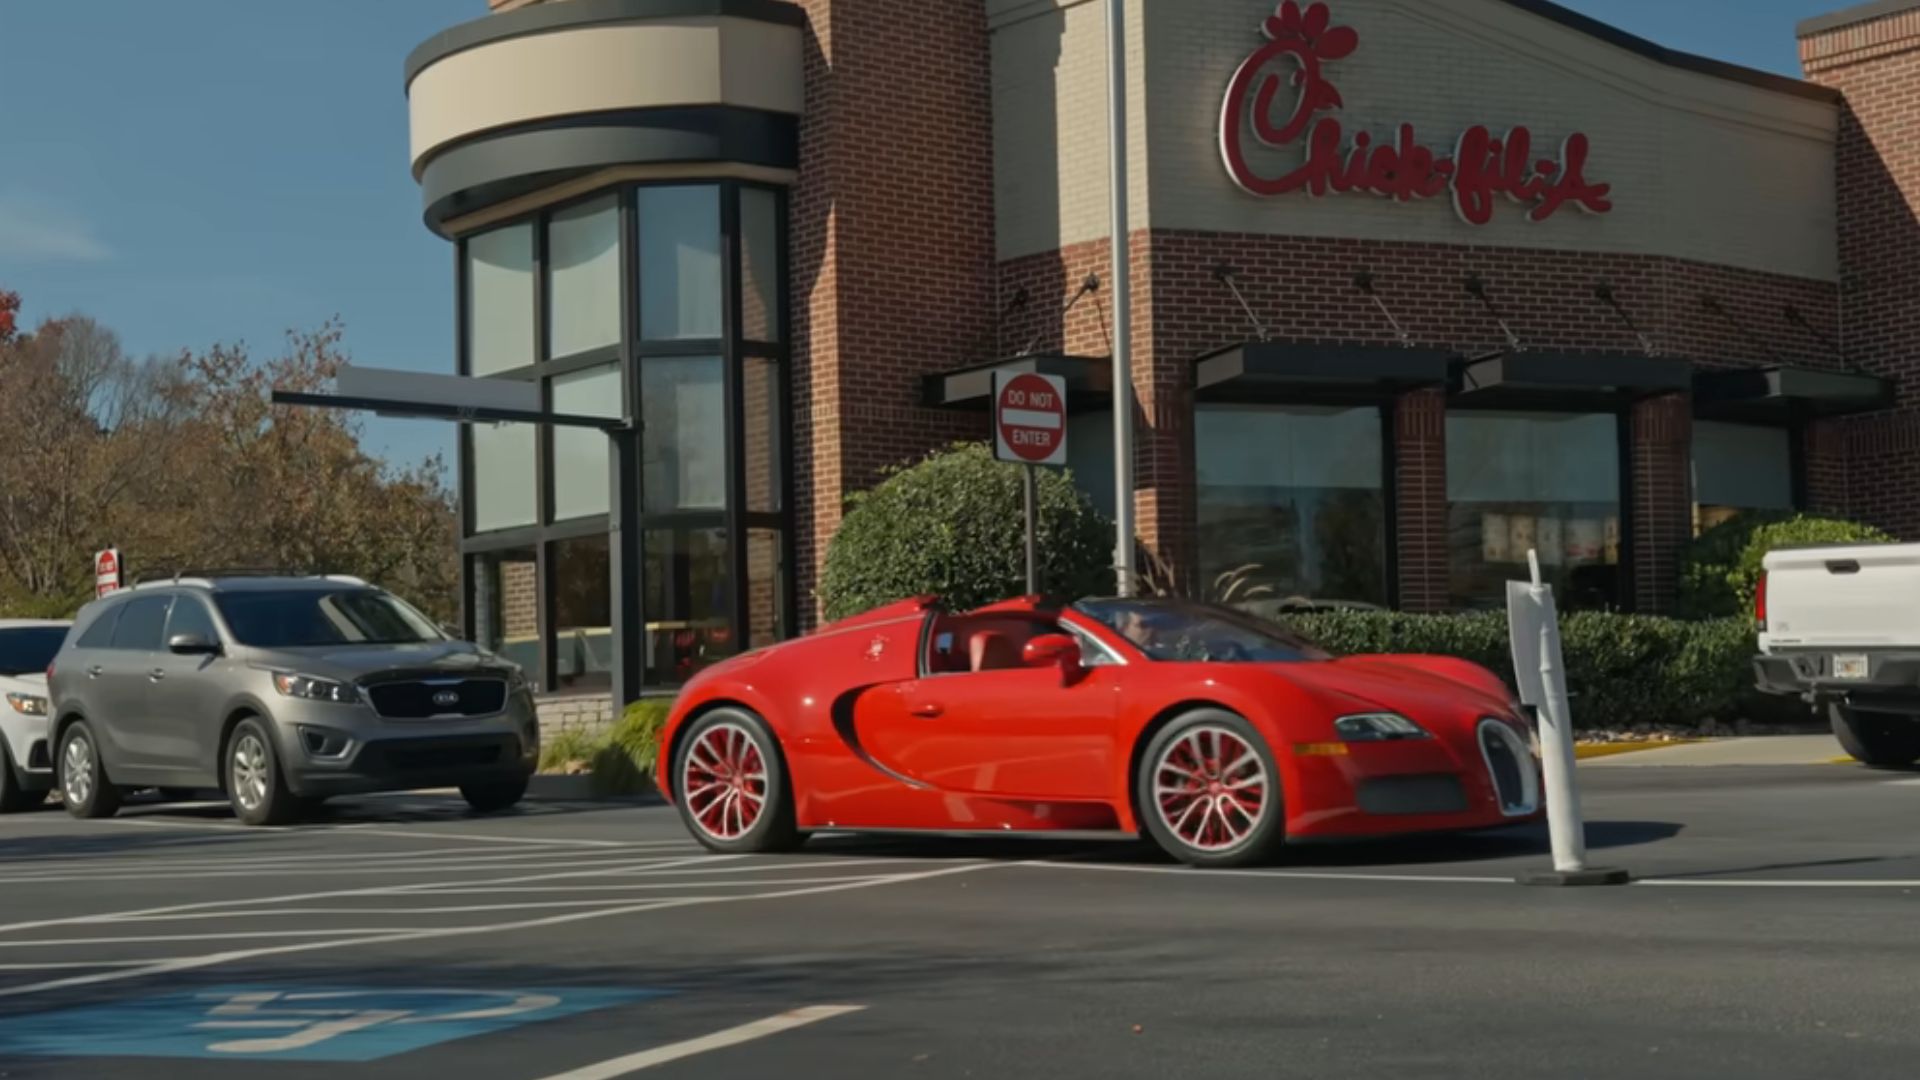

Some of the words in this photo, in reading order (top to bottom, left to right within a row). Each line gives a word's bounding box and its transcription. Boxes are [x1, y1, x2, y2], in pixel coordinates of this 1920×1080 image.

[1219, 0, 1613, 225] Chick-fil-A
[1008, 390, 1025, 405] DO
[1029, 392, 1053, 408] NOT
[1012, 429, 1051, 446] ENTER
